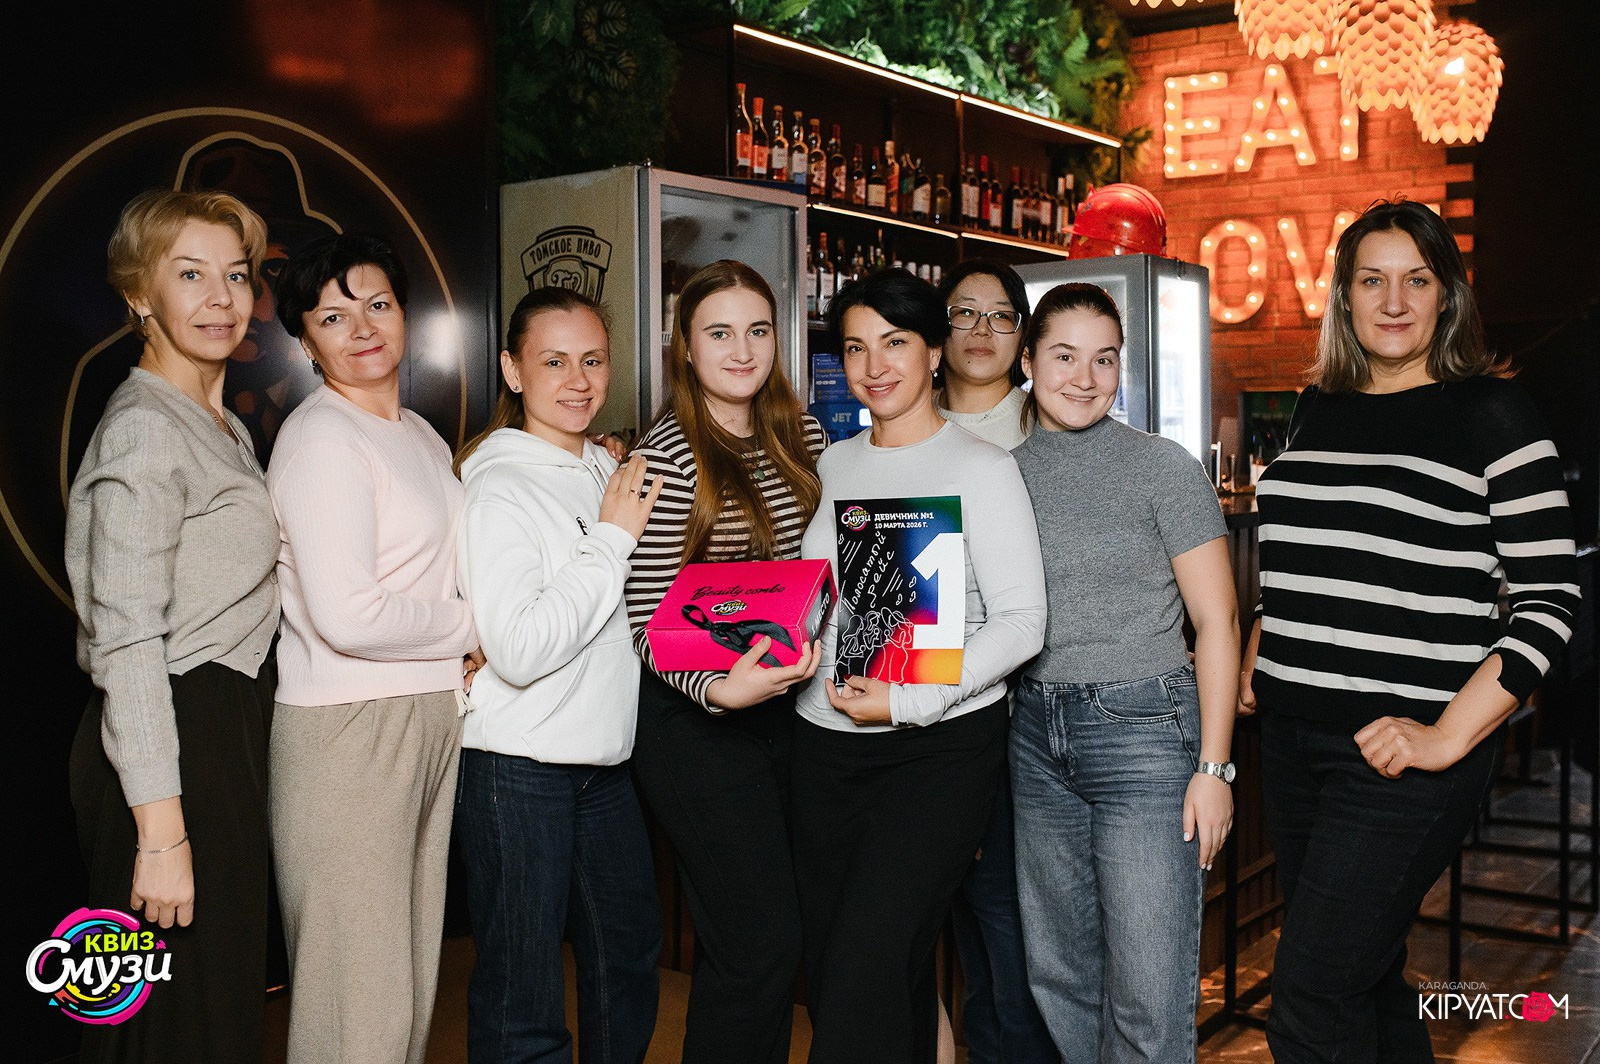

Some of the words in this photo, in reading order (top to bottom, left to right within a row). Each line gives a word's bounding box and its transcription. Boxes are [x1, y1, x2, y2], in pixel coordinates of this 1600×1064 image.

[1164, 56, 1360, 179] EAT
[529, 238, 572, 265] ТОМСКОЕ
[576, 237, 601, 259] ПИВО
[832, 413, 852, 423] JET
[874, 512, 919, 522] ДЕВИЧНИК
[920, 511, 934, 520] №1
[690, 585, 744, 601] Beauty
[744, 583, 786, 596] combo
[910, 532, 964, 650] 1
